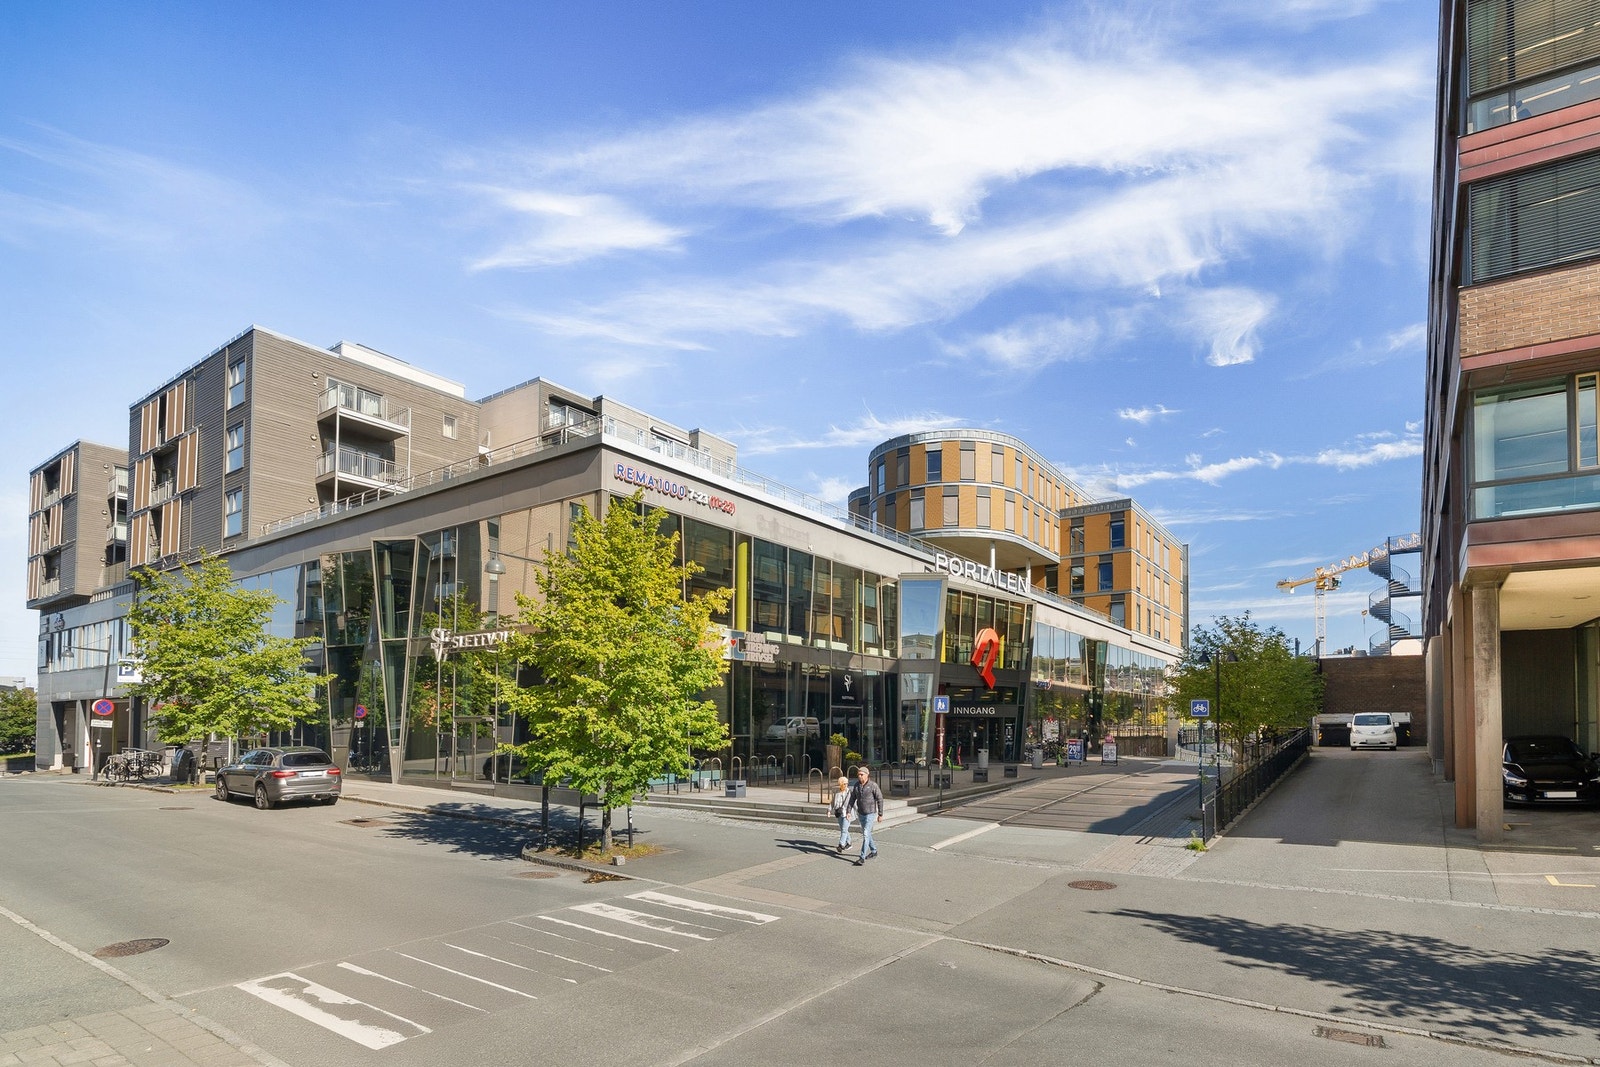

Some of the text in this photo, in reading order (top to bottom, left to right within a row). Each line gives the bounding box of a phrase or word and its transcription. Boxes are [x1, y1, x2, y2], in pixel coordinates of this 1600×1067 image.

[615, 462, 655, 488] REMA
[657, 477, 687, 499] 1000
[934, 554, 1031, 594] PORTALEN
[953, 706, 996, 715] INNGANG
